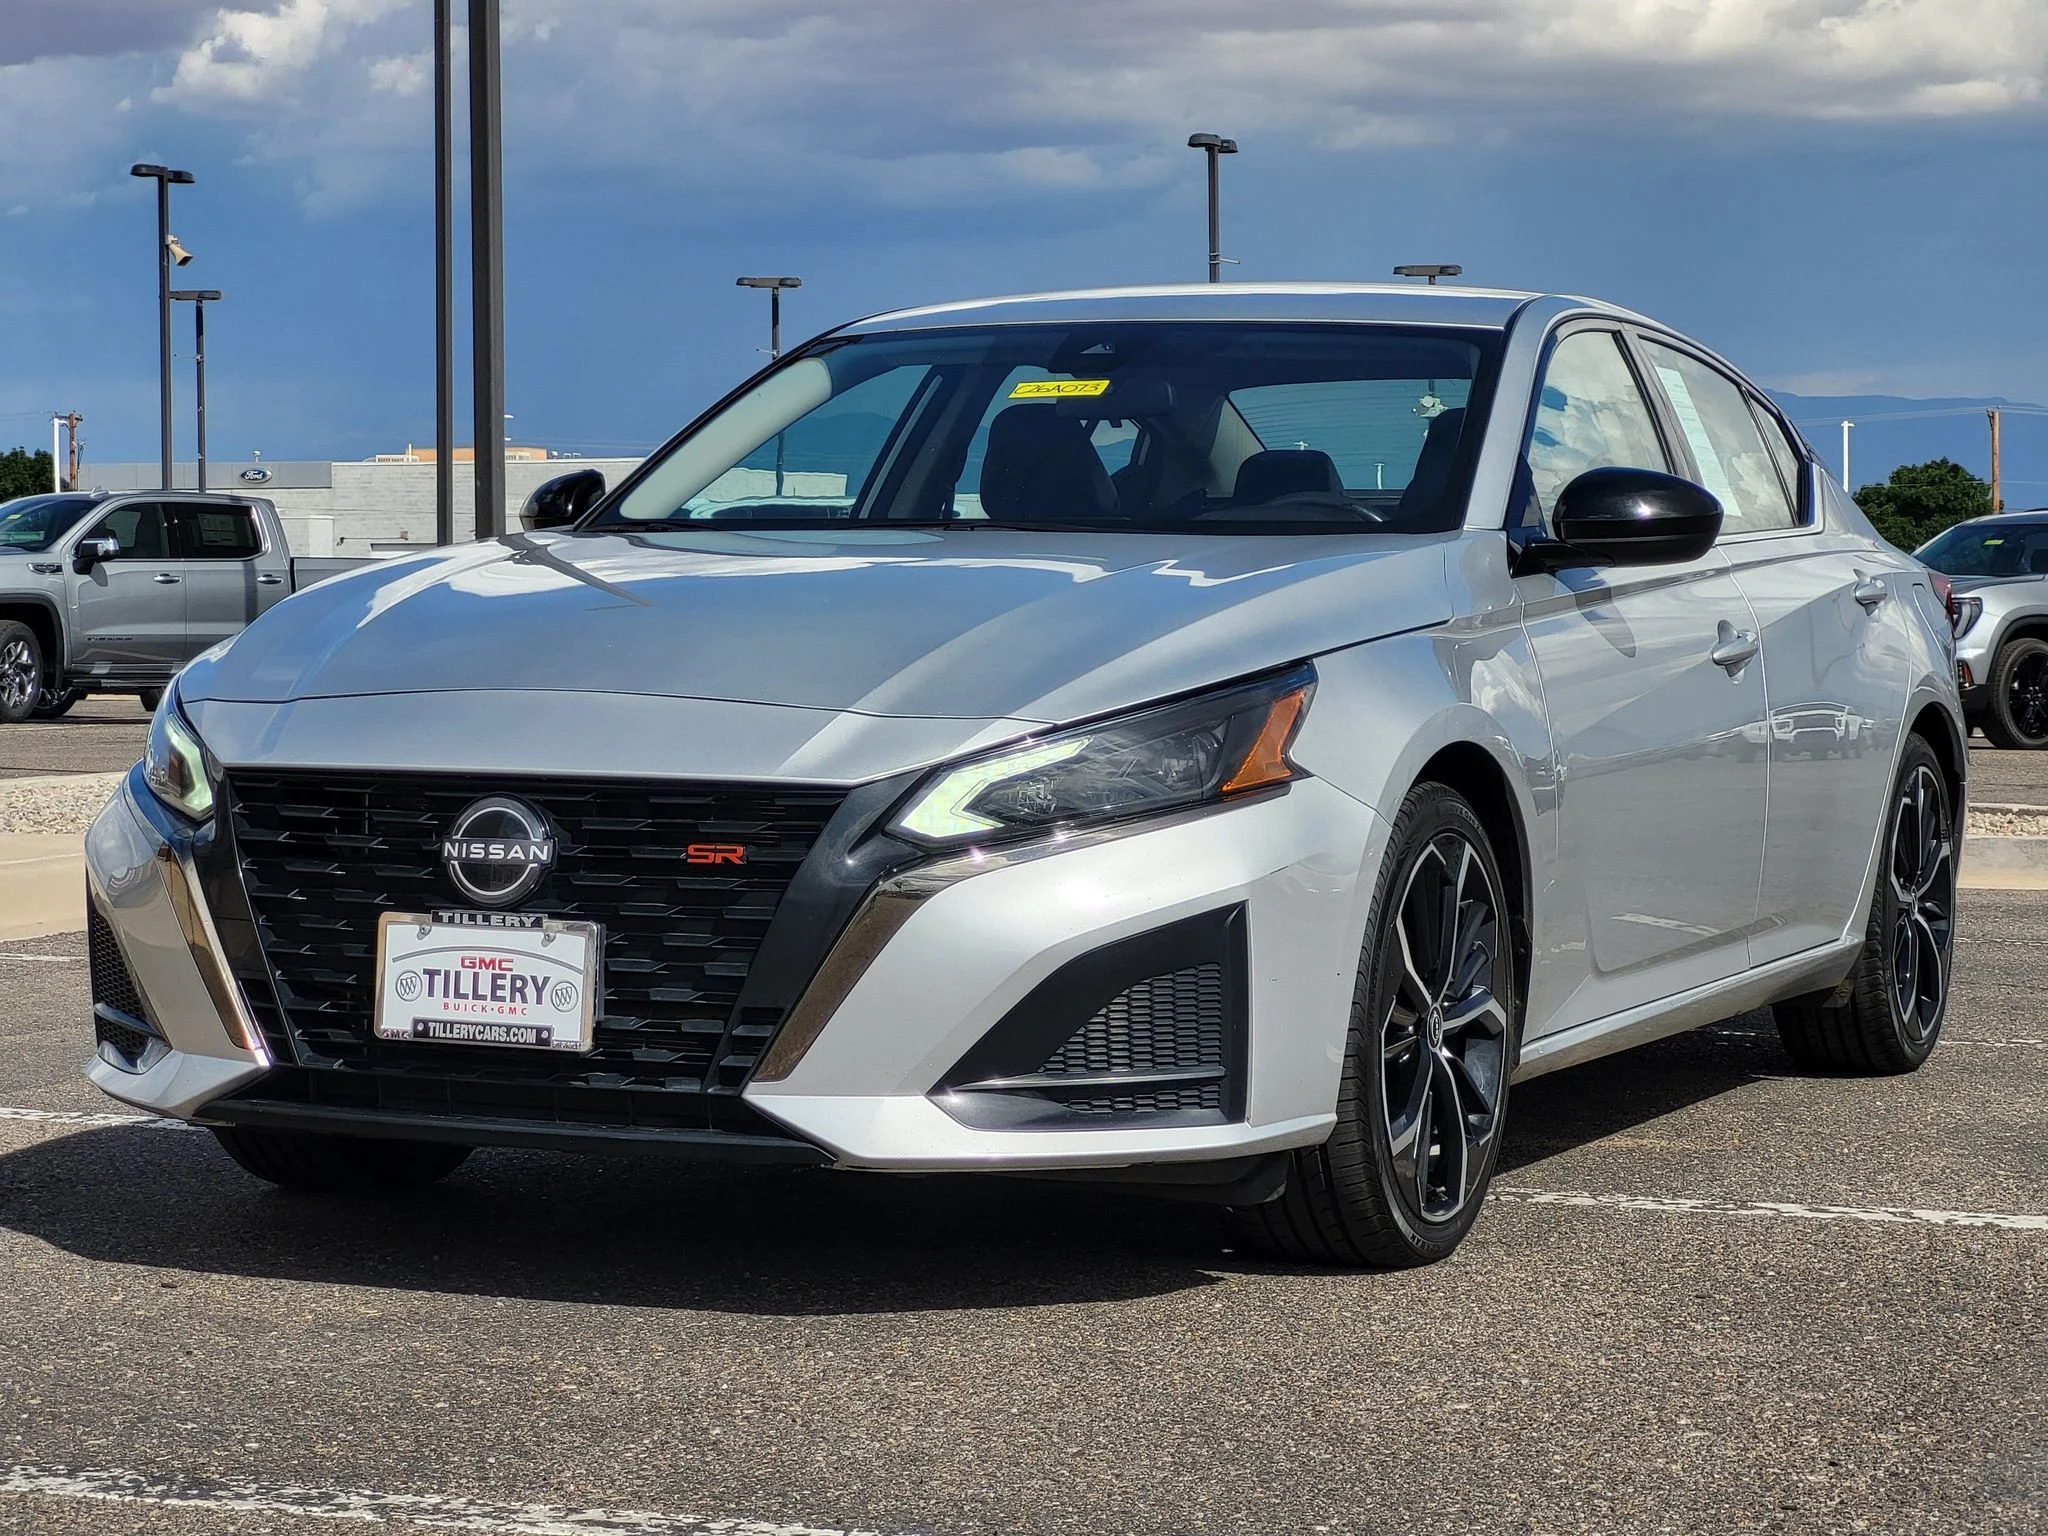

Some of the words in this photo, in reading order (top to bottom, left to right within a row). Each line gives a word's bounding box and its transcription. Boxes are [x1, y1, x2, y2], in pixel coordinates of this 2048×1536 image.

[444, 841, 549, 861] NISSAN
[686, 843, 746, 864] SR
[438, 911, 538, 928] TILLERY
[460, 955, 514, 972] GMC
[422, 968, 551, 1005] TILLERY
[428, 1021, 537, 1044] TILLERYCARS.COM
